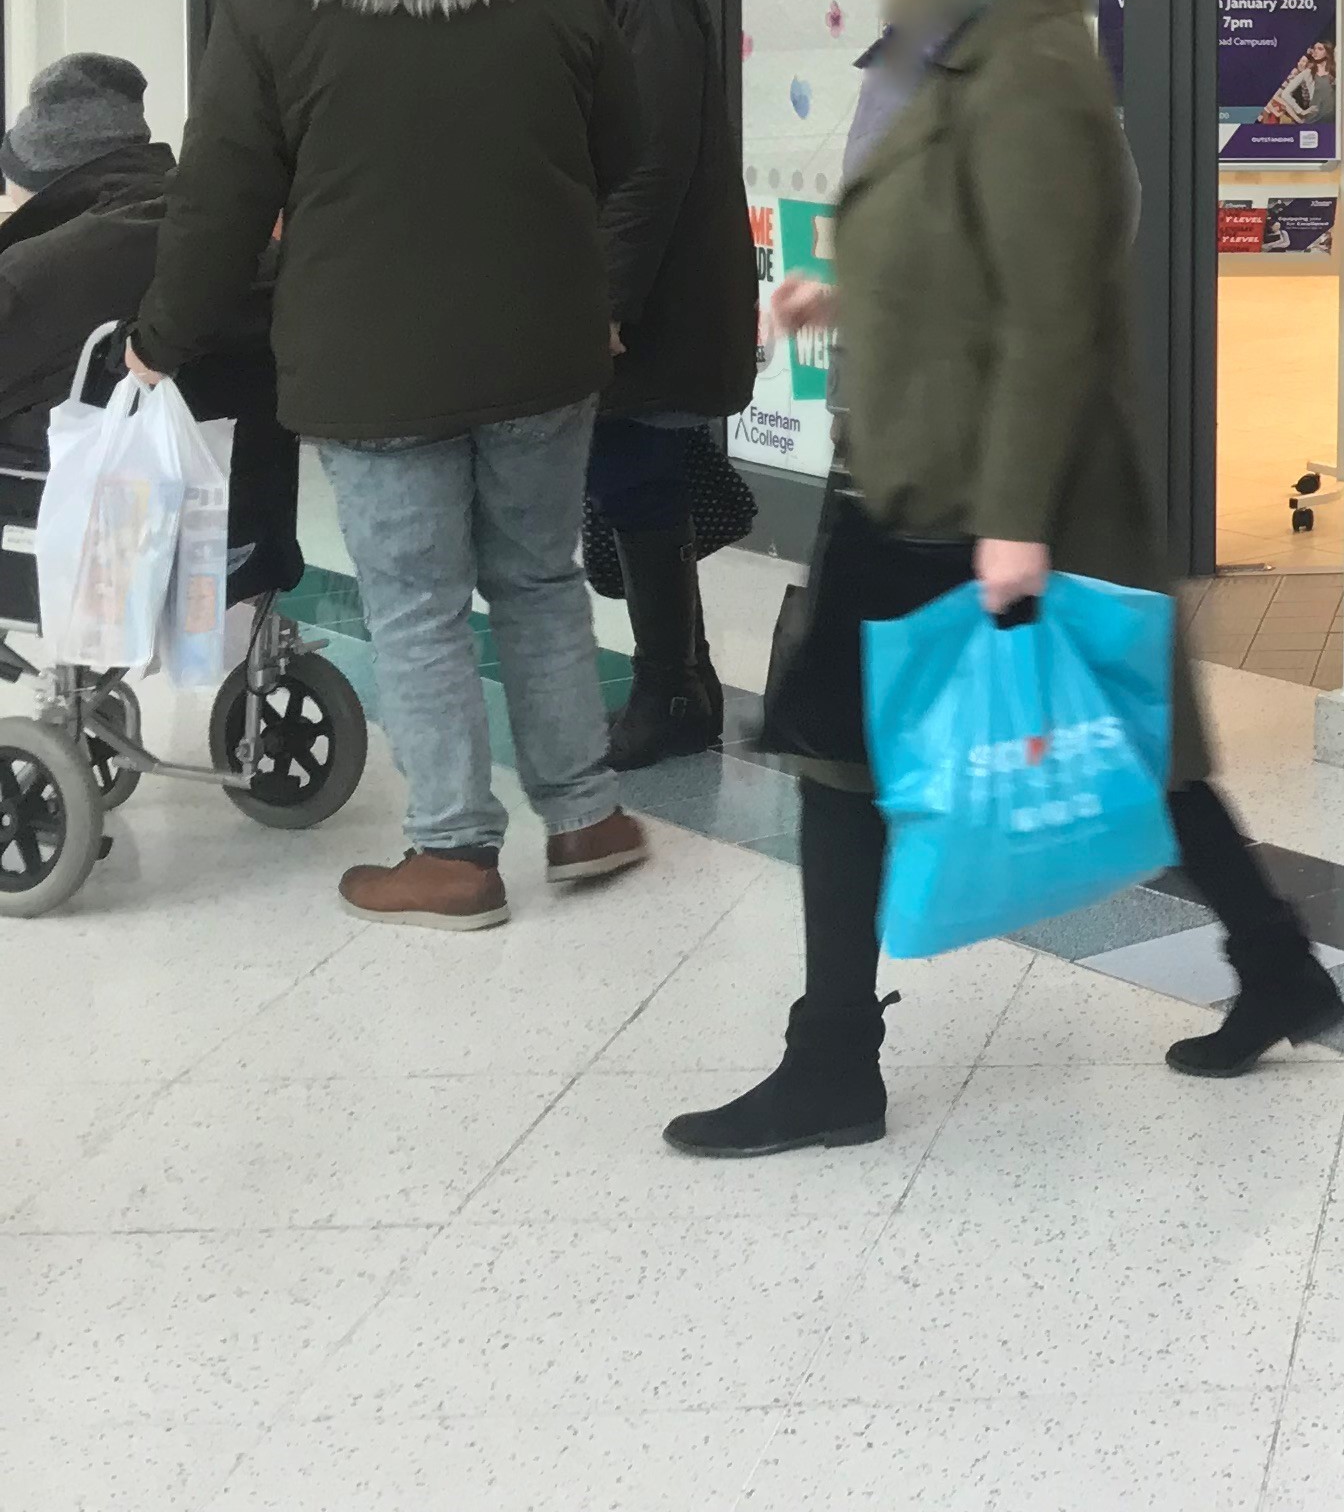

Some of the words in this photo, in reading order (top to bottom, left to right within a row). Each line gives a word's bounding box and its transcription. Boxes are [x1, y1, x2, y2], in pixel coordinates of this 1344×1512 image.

[1223, 16, 1253, 31] 7pm
[1234, 37, 1277, 48] Campuses)
[749, 206, 774, 247] ME
[750, 406, 801, 432] Fareham
[750, 426, 795, 454] College
